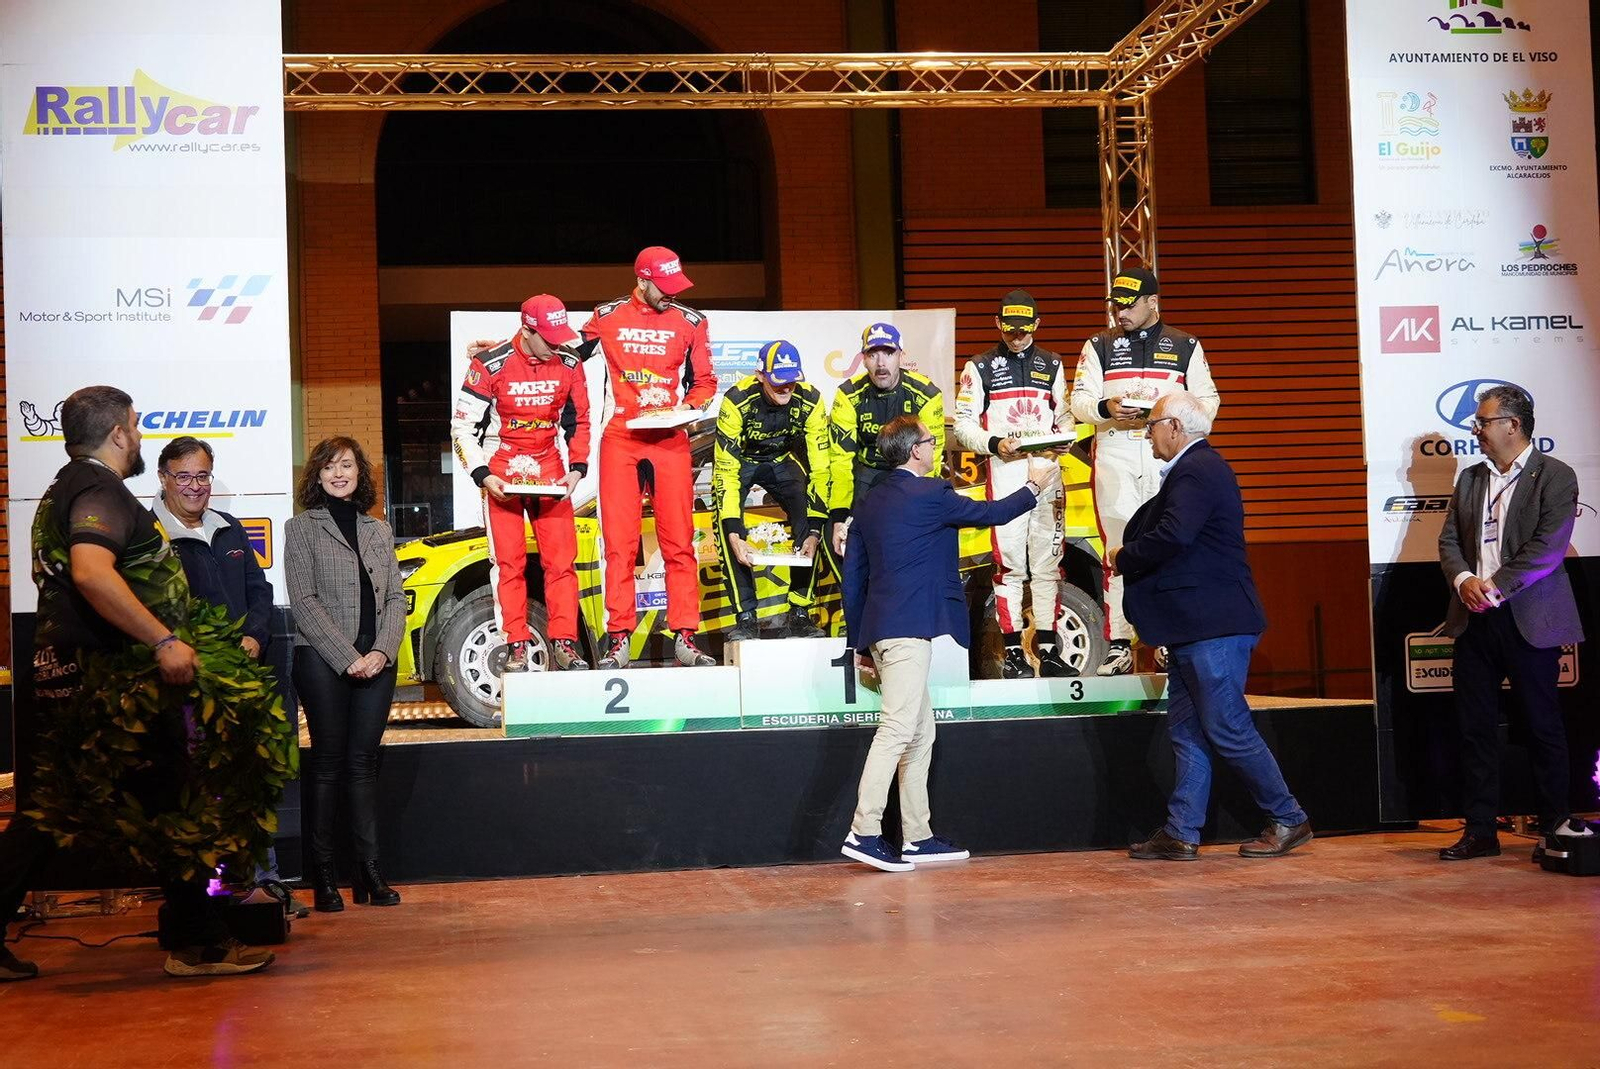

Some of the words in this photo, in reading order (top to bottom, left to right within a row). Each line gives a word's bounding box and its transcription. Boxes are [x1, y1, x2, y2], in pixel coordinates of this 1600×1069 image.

[1389, 53, 1489, 63] AYUNTAMIENTO
[1493, 52, 1509, 62] DE
[1512, 52, 1526, 62] EL
[1529, 51, 1558, 62] VISO
[36, 86, 260, 135] Rallycar
[128, 141, 261, 153] www.rallycar.es
[1378, 141, 1391, 156] El
[1396, 141, 1441, 160] Guijo
[19, 311, 60, 322] Motor
[64, 312, 71, 321] &
[74, 311, 113, 323] Sport
[117, 311, 171, 322] Institute
[1451, 317, 1484, 331] AL
[617, 328, 675, 343] MRF
[623, 343, 666, 355] TYRES
[507, 380, 559, 395] MRF
[514, 395, 555, 407] TYRES
[136, 410, 267, 429] CHELIN
[1420, 437, 1555, 456] CORHD
[961, 452, 978, 482] 5
[831, 649, 857, 704] 1
[604, 678, 630, 714] 2
[1069, 681, 1084, 700] 3
[762, 715, 839, 725] ESCUDERIA
[844, 712, 880, 722] SIERR
